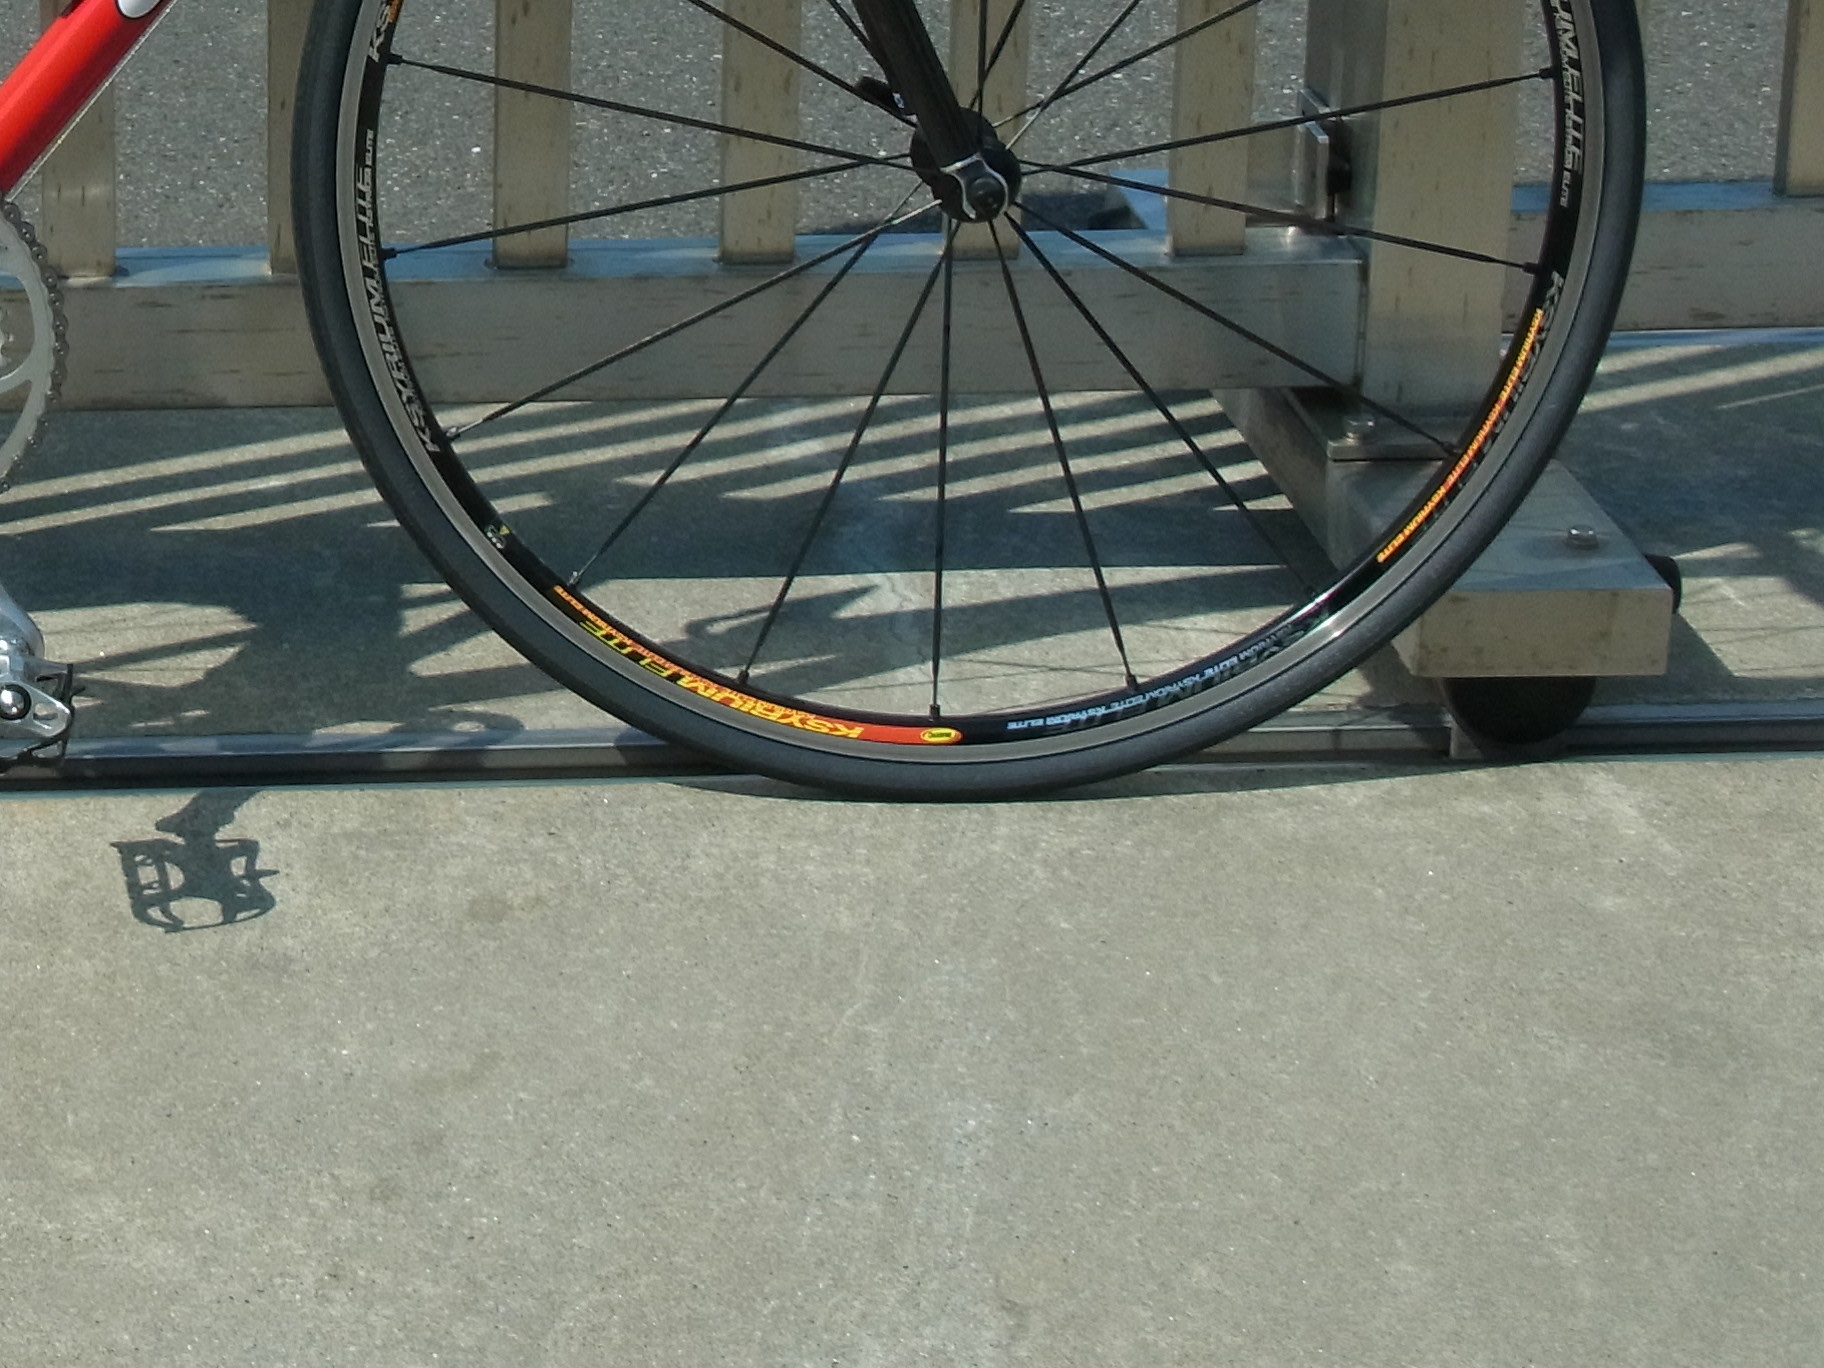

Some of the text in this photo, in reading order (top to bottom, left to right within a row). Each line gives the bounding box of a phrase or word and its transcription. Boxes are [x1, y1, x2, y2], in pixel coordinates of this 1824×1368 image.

[363, 276, 442, 458] KSYRIUM
[577, 615, 865, 739] KSYRIUM ELITE
